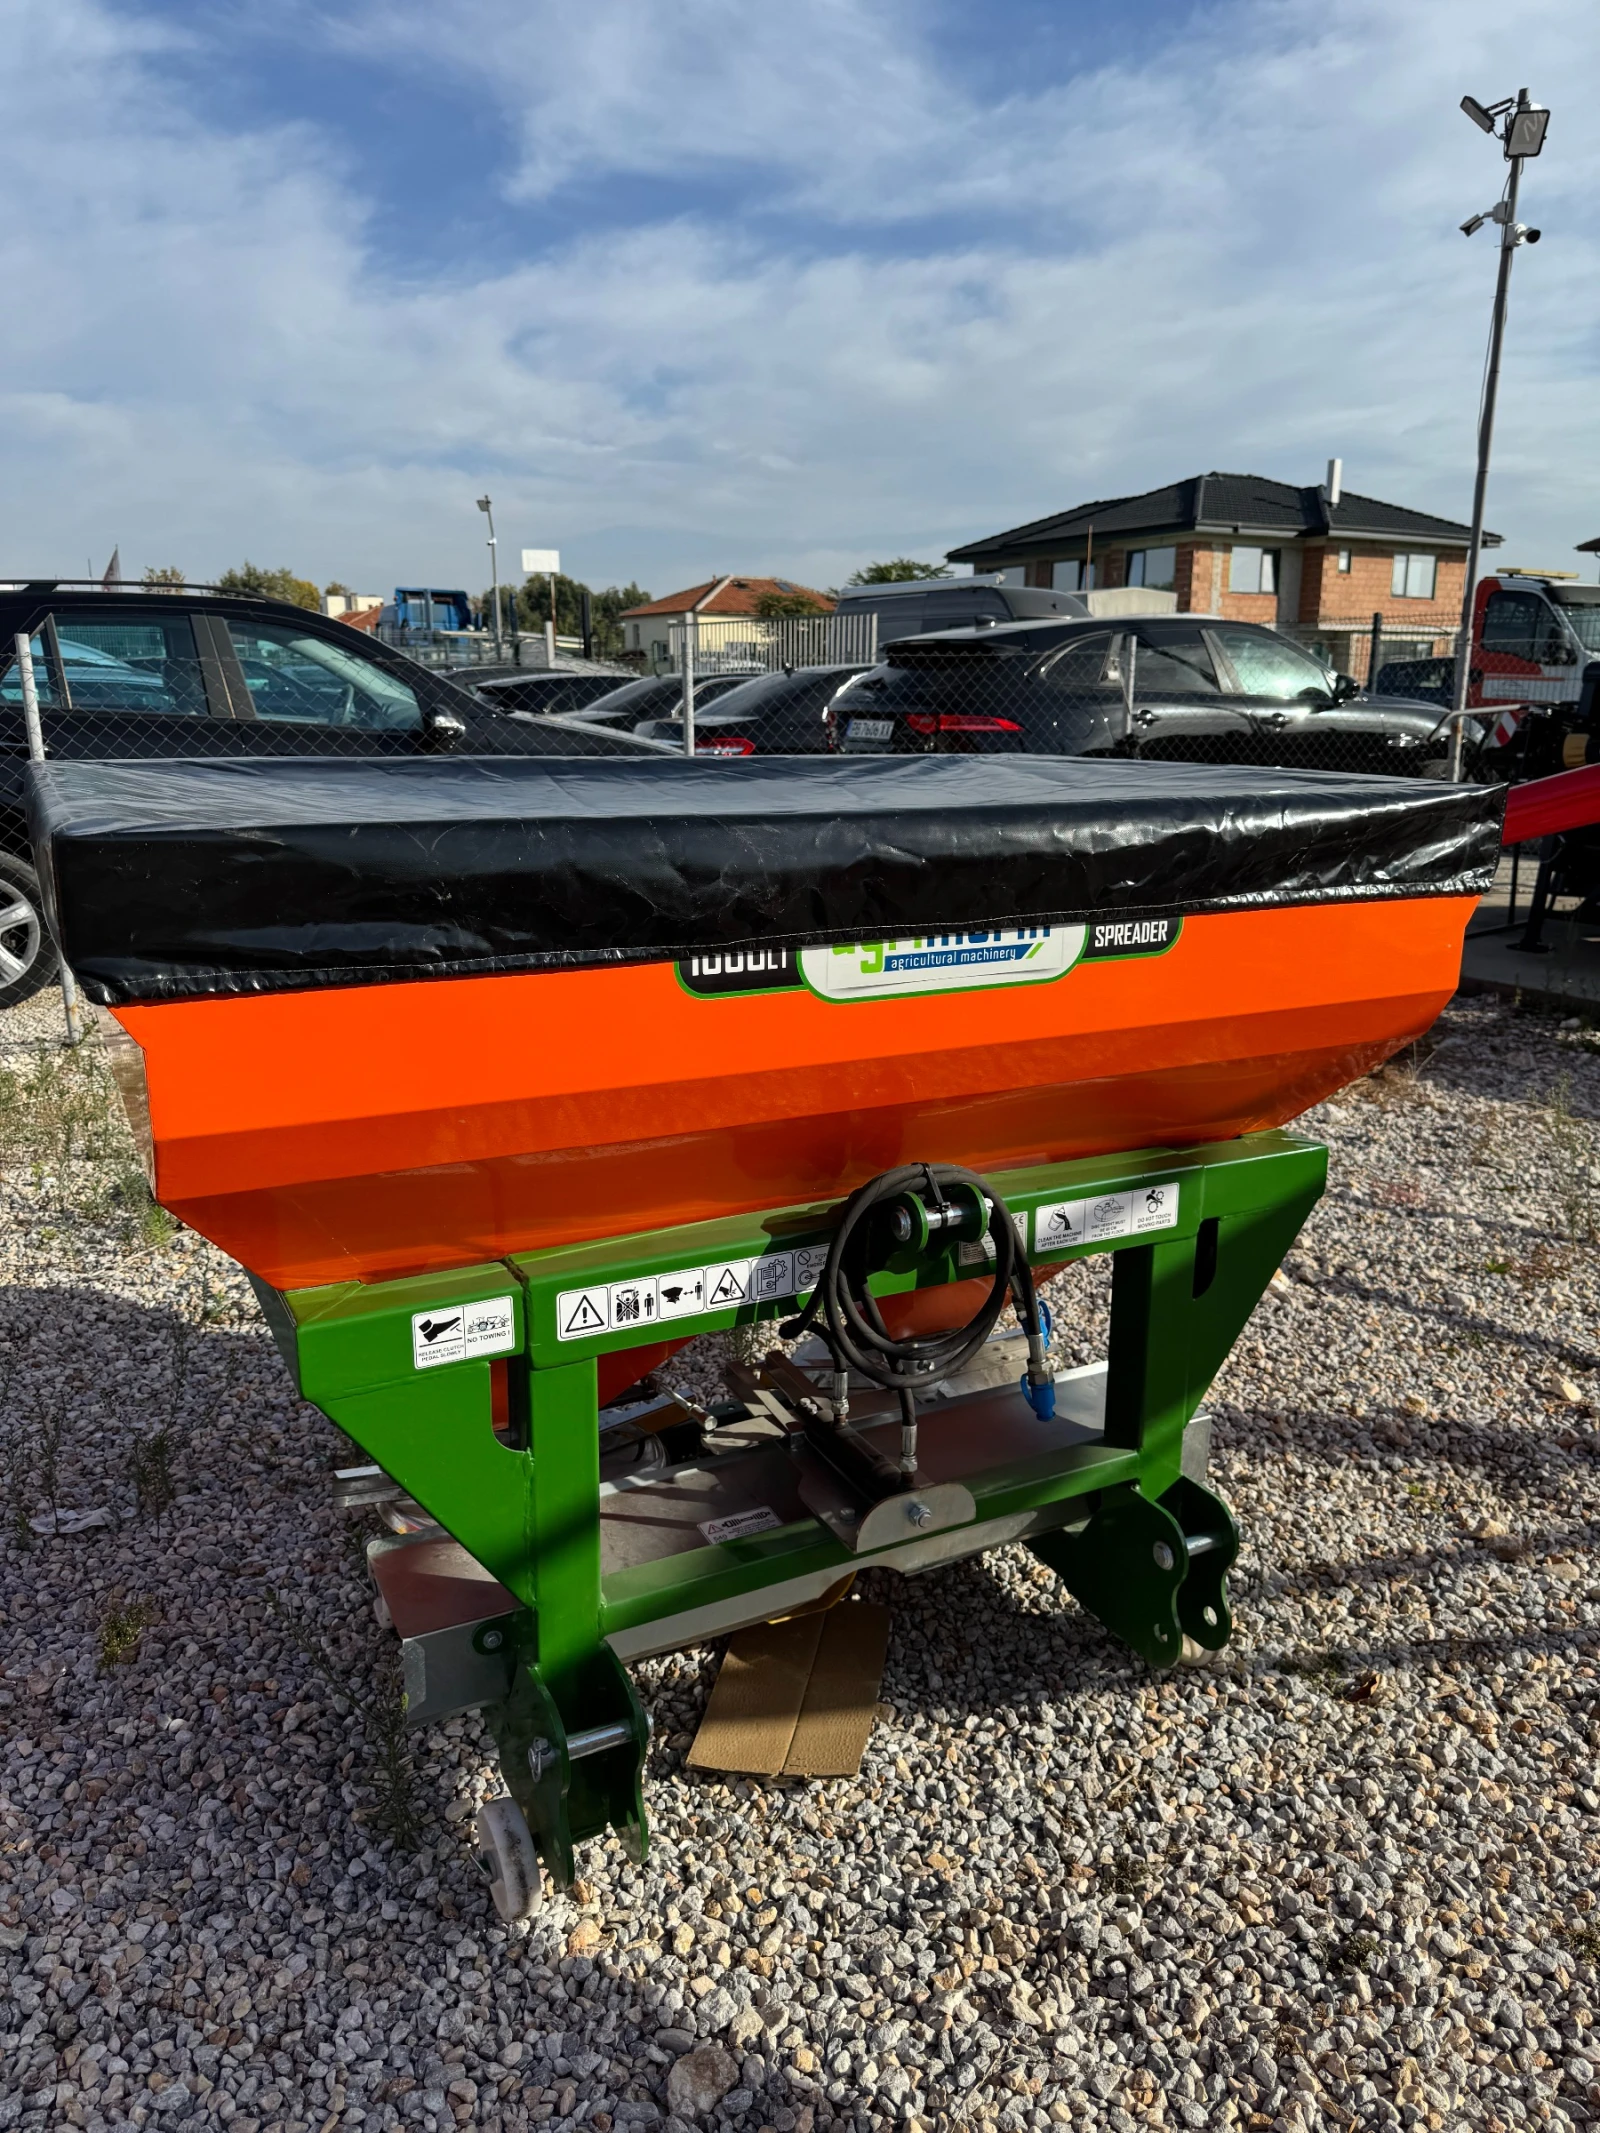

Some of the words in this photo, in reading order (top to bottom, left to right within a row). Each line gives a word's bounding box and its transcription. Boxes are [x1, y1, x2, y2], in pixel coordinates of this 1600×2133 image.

[1095, 920, 1168, 947] SPREADER
[891, 951, 957, 971] agricultural
[960, 948, 1016, 963] machinery
[479, 1330, 507, 1341] TOWING
[418, 1349, 442, 1357] RELEASE
[442, 1344, 464, 1352] CLUTCH
